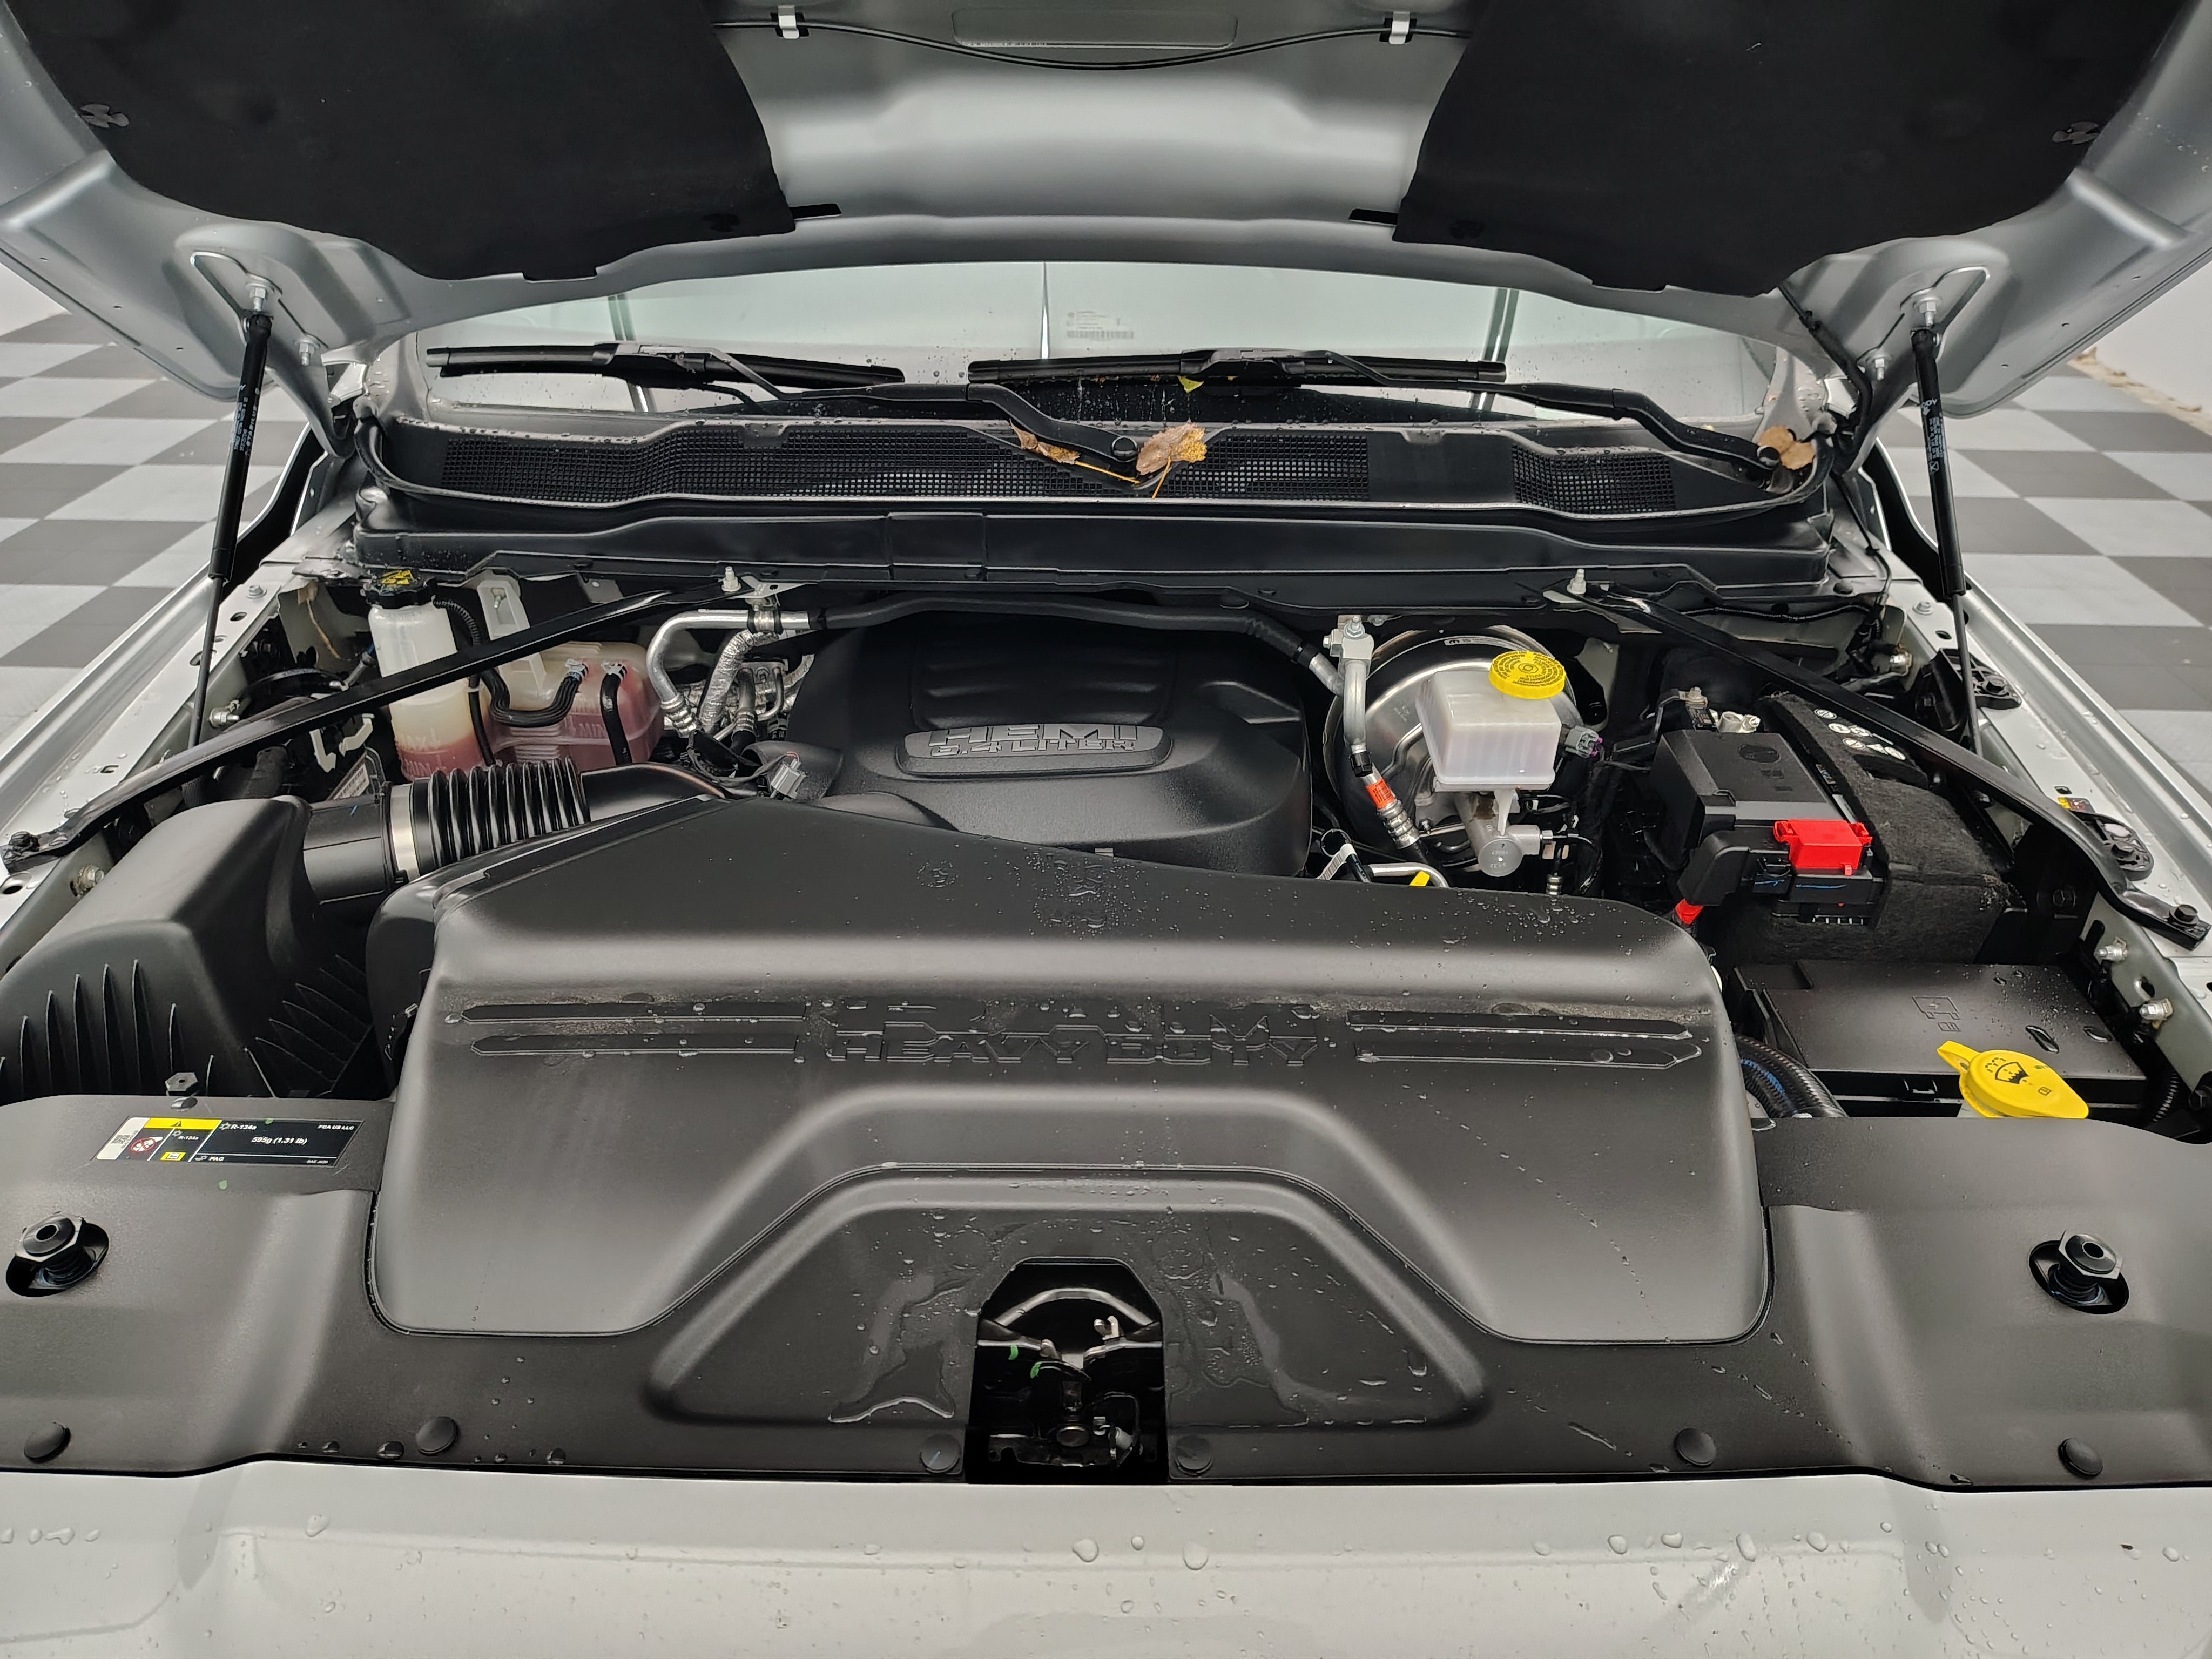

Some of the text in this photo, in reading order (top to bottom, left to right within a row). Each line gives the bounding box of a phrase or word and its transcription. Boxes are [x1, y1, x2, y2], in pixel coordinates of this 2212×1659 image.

[928, 723, 1139, 746] HEMI
[930, 738, 1136, 757] 6.4 LITER
[827, 1034, 1318, 1067] HEAVY DUTY
[251, 1136, 273, 1144] 595g
